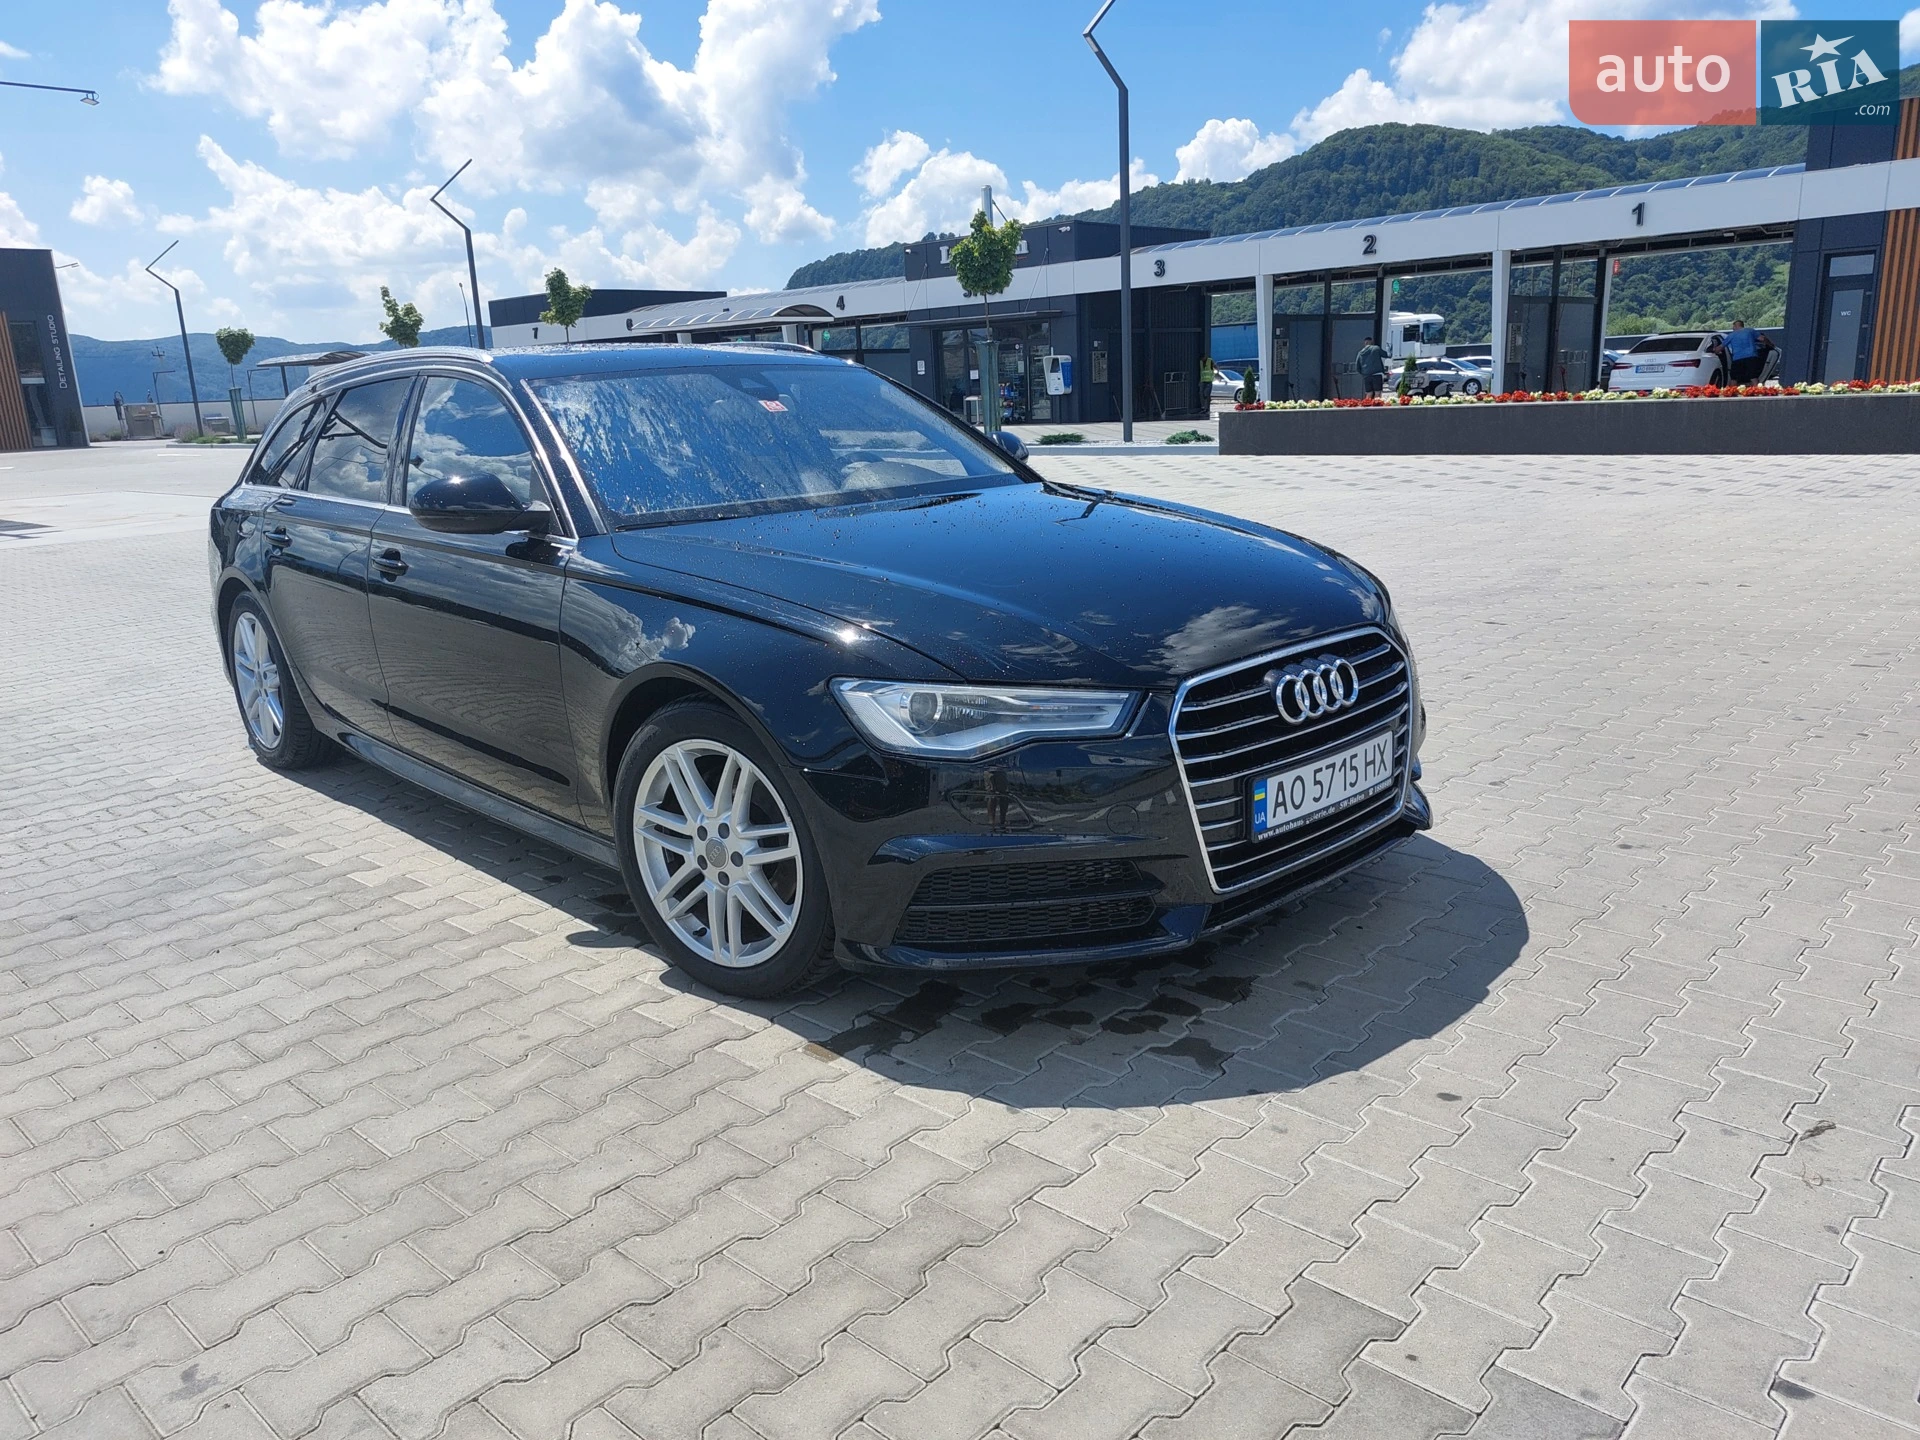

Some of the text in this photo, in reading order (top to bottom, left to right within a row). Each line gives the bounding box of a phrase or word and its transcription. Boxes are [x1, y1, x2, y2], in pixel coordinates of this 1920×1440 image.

[1631, 202, 1645, 226] 1
[1362, 234, 1377, 255] 2
[1154, 259, 1165, 278] 3
[836, 295, 845, 311] 4
[47, 314, 68, 389] DETAILING STUDIO
[1272, 775, 1306, 819] AO
[1312, 753, 1359, 803] 5715
[1364, 739, 1388, 782] HX
[1254, 811, 1266, 825] UA
